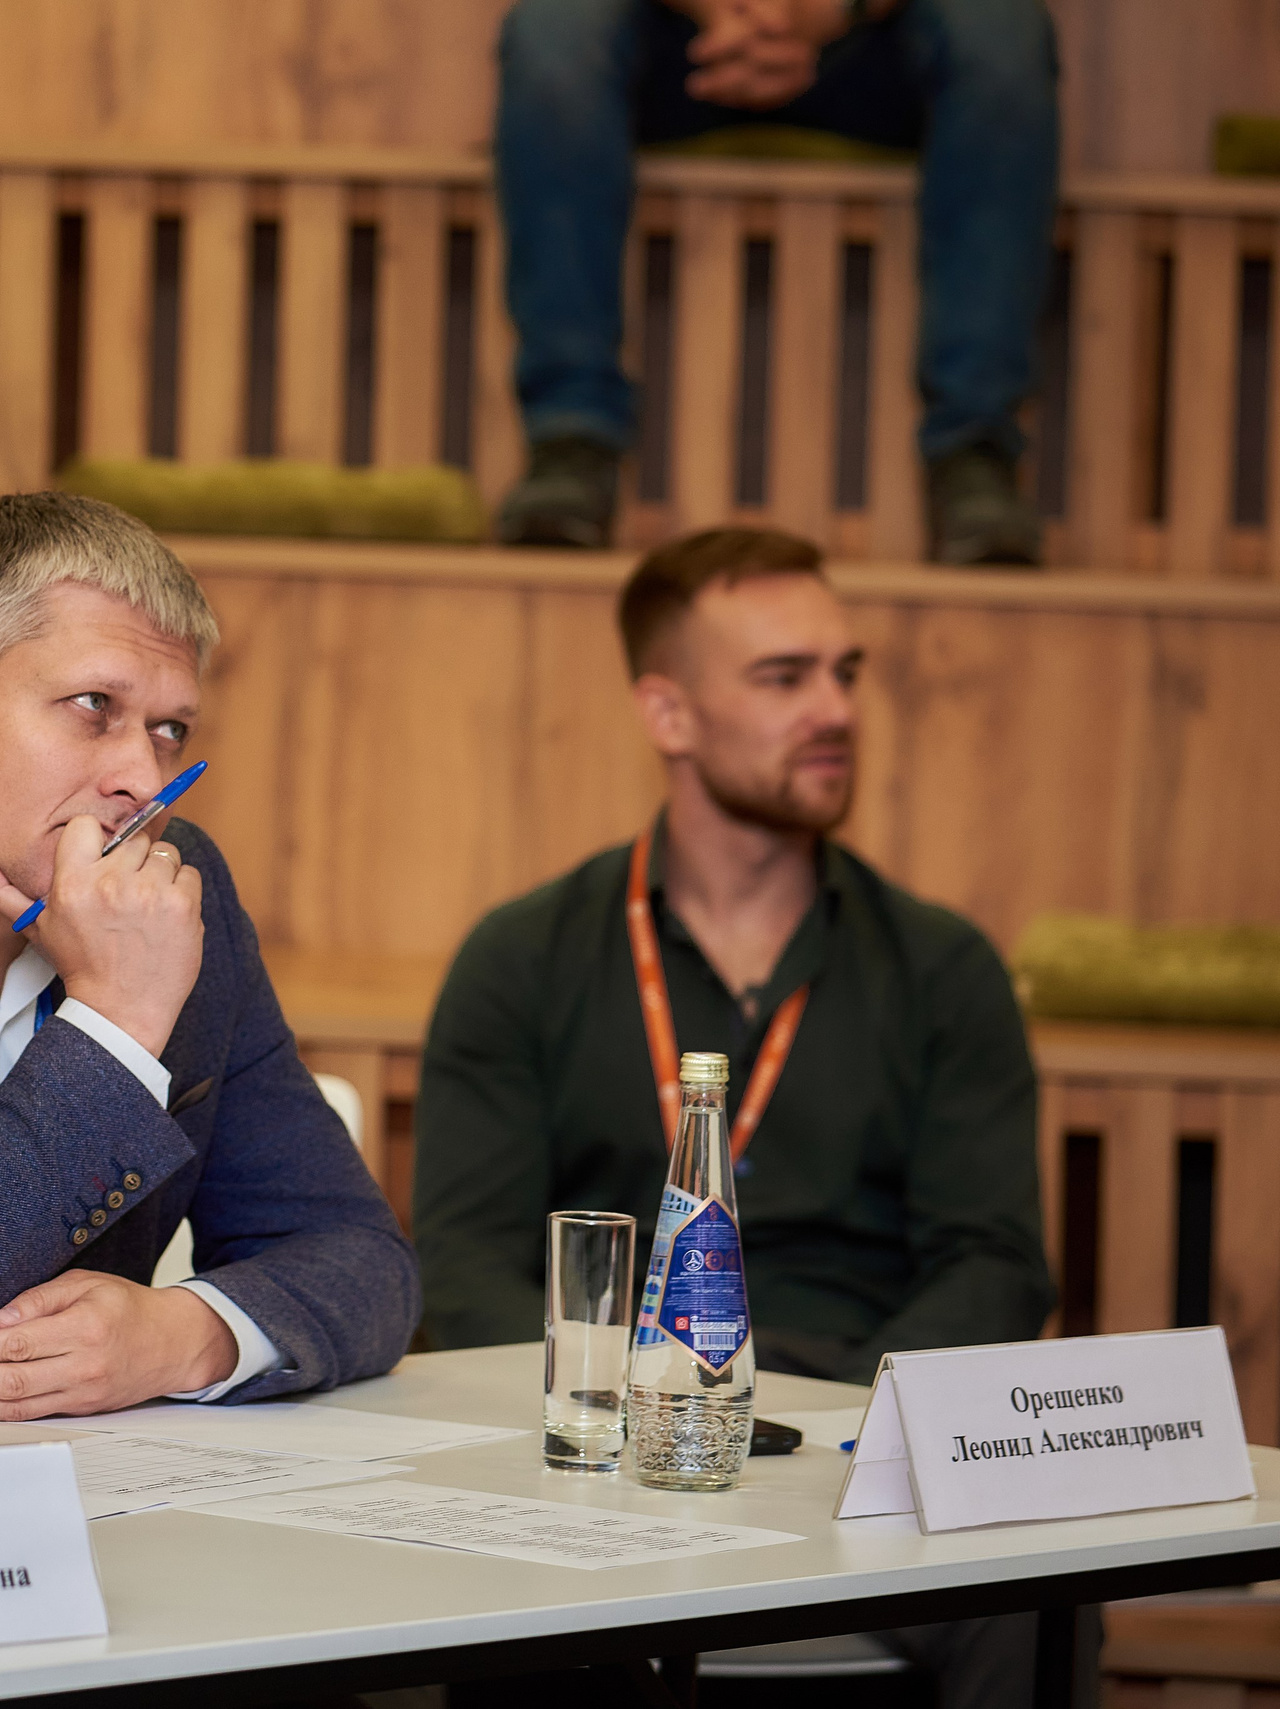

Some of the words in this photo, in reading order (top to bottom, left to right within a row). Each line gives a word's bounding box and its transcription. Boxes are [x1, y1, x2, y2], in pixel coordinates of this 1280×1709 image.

[1010, 1384, 1124, 1419] Орещенко
[951, 1435, 1034, 1463] Леонид
[1040, 1419, 1204, 1453] Александрович
